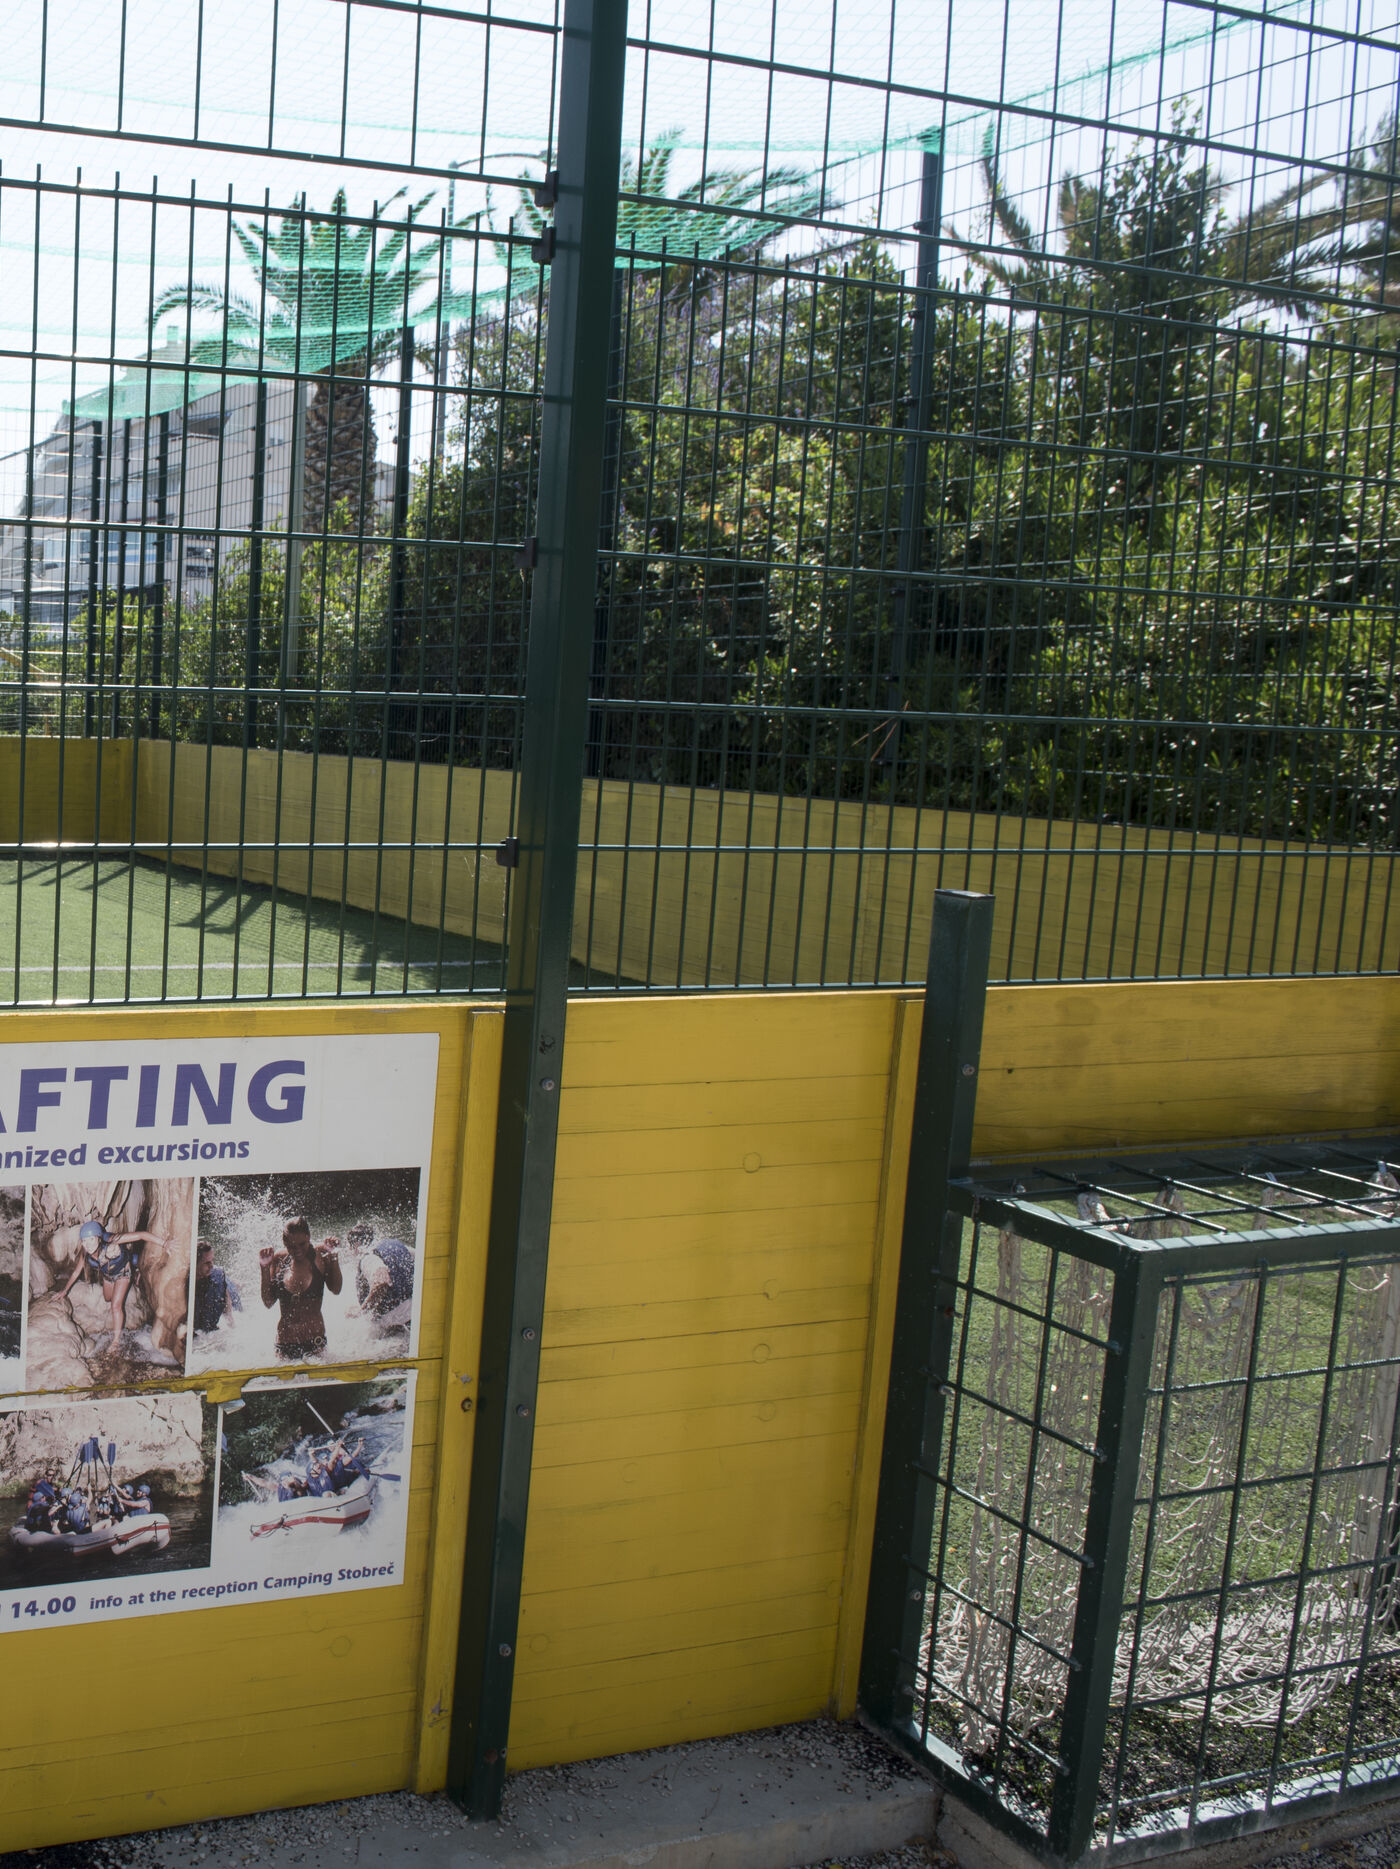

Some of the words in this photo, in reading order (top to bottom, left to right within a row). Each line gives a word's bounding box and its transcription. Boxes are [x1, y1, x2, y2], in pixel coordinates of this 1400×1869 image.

[98, 1139, 249, 1164] excursions
[12, 1596, 76, 1618] 14.00
[90, 1596, 122, 1609] info
[128, 1593, 144, 1605] at
[150, 1590, 176, 1602] the
[182, 1581, 257, 1598] reception
[264, 1573, 332, 1589] Camping
[337, 1562, 394, 1581] Stobreč
